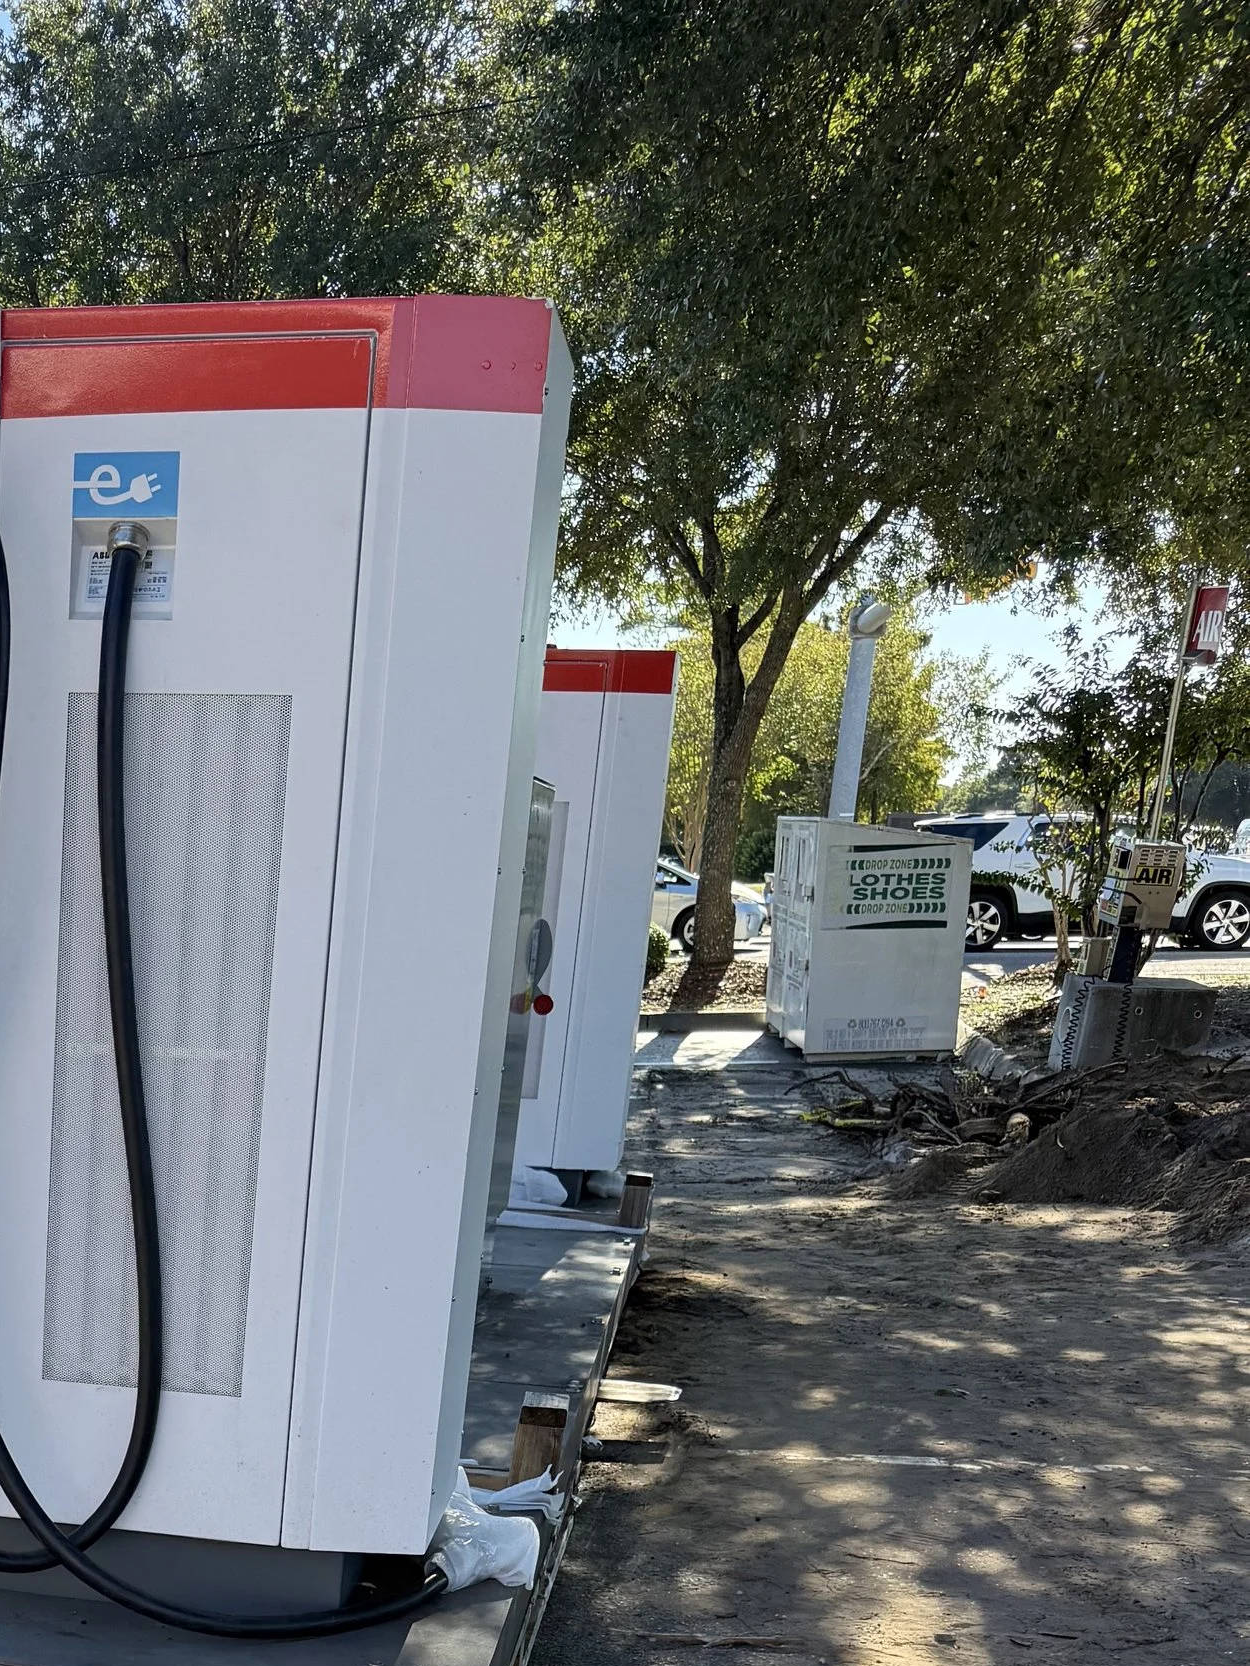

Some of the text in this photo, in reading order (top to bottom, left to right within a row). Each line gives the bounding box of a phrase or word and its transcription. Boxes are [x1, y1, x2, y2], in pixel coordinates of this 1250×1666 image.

[1192, 610, 1222, 642] AIR
[865, 858, 913, 871] DROP ZONE
[850, 872, 946, 887] LOTHES
[1136, 867, 1172, 885] AIR
[852, 886, 945, 901] SHOES
[861, 902, 909, 915] DROP ZONE
